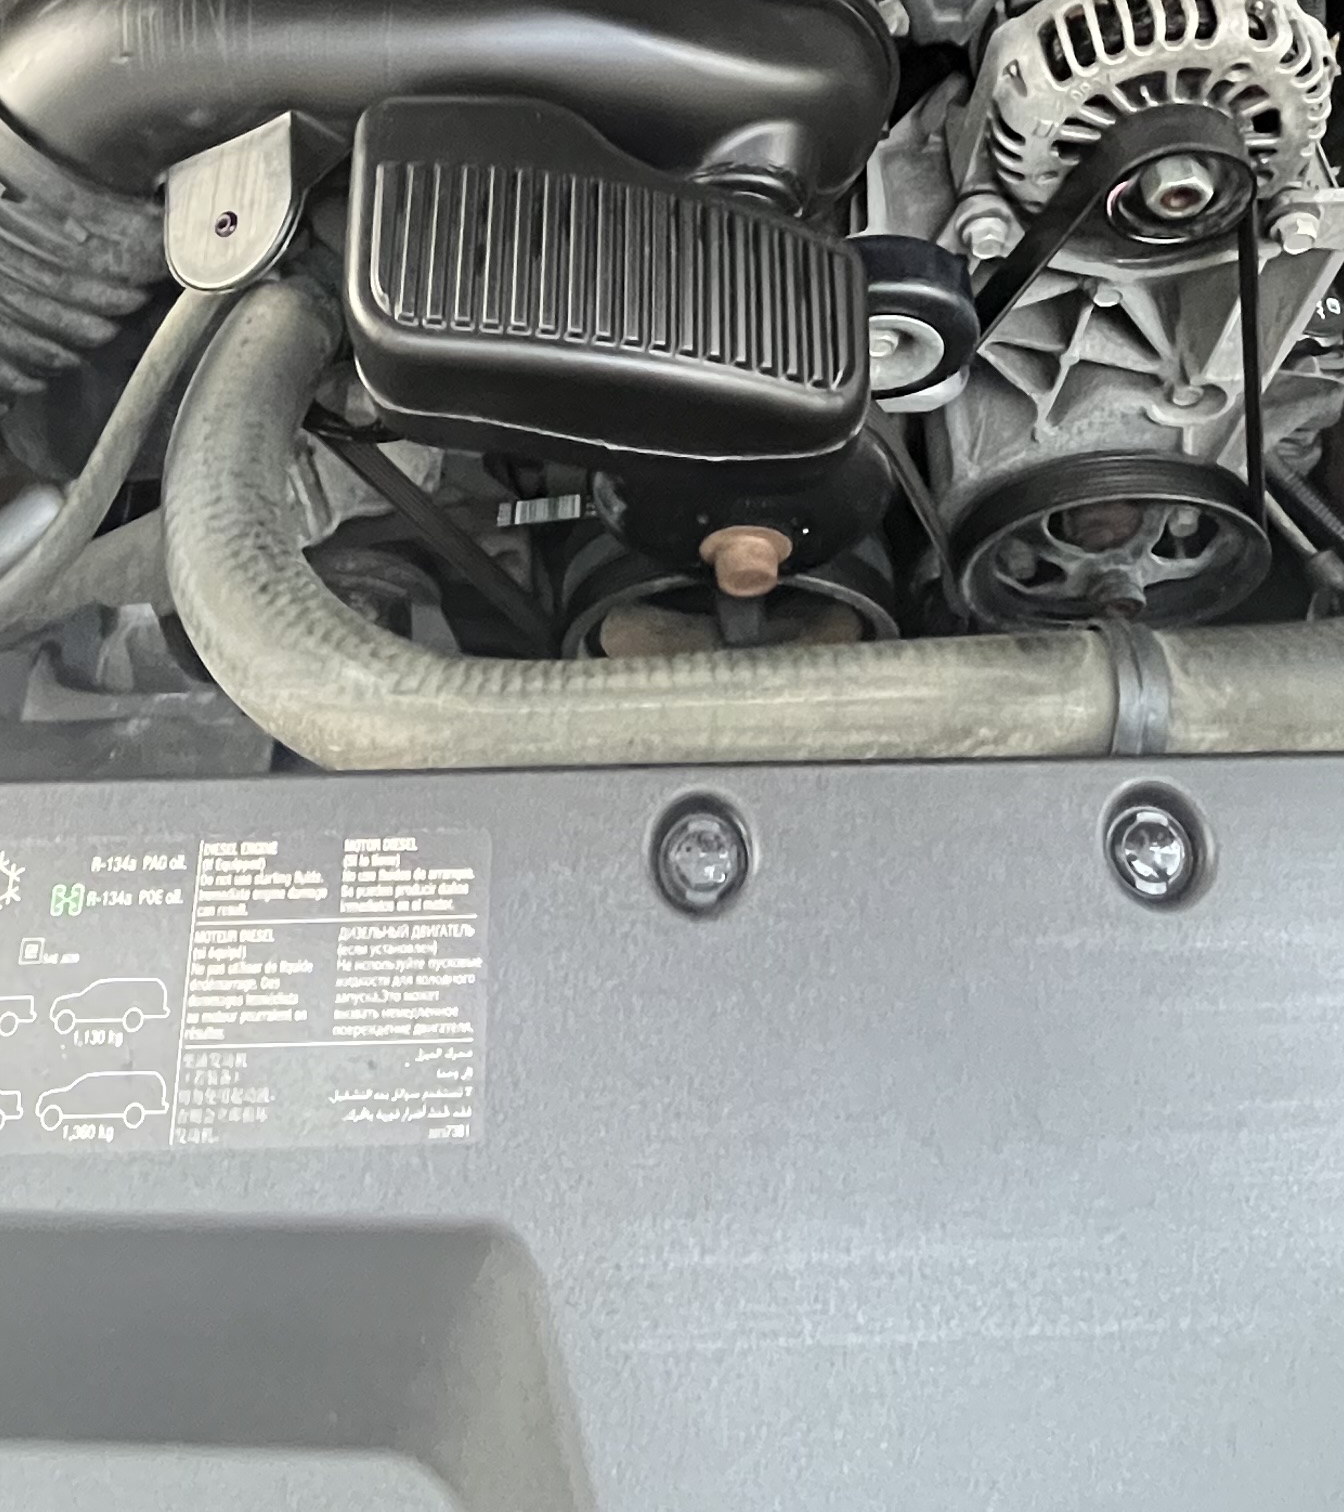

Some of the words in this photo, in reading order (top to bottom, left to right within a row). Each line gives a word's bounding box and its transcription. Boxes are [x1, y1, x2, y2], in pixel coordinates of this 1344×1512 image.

[91, 854, 137, 872] R-134a
[86, 890, 132, 906] R-134a
[411, 924, 476, 940] ДВИГАТЕЛЬ
[108, 1029, 123, 1047] kg
[98, 1124, 113, 1142] kg
